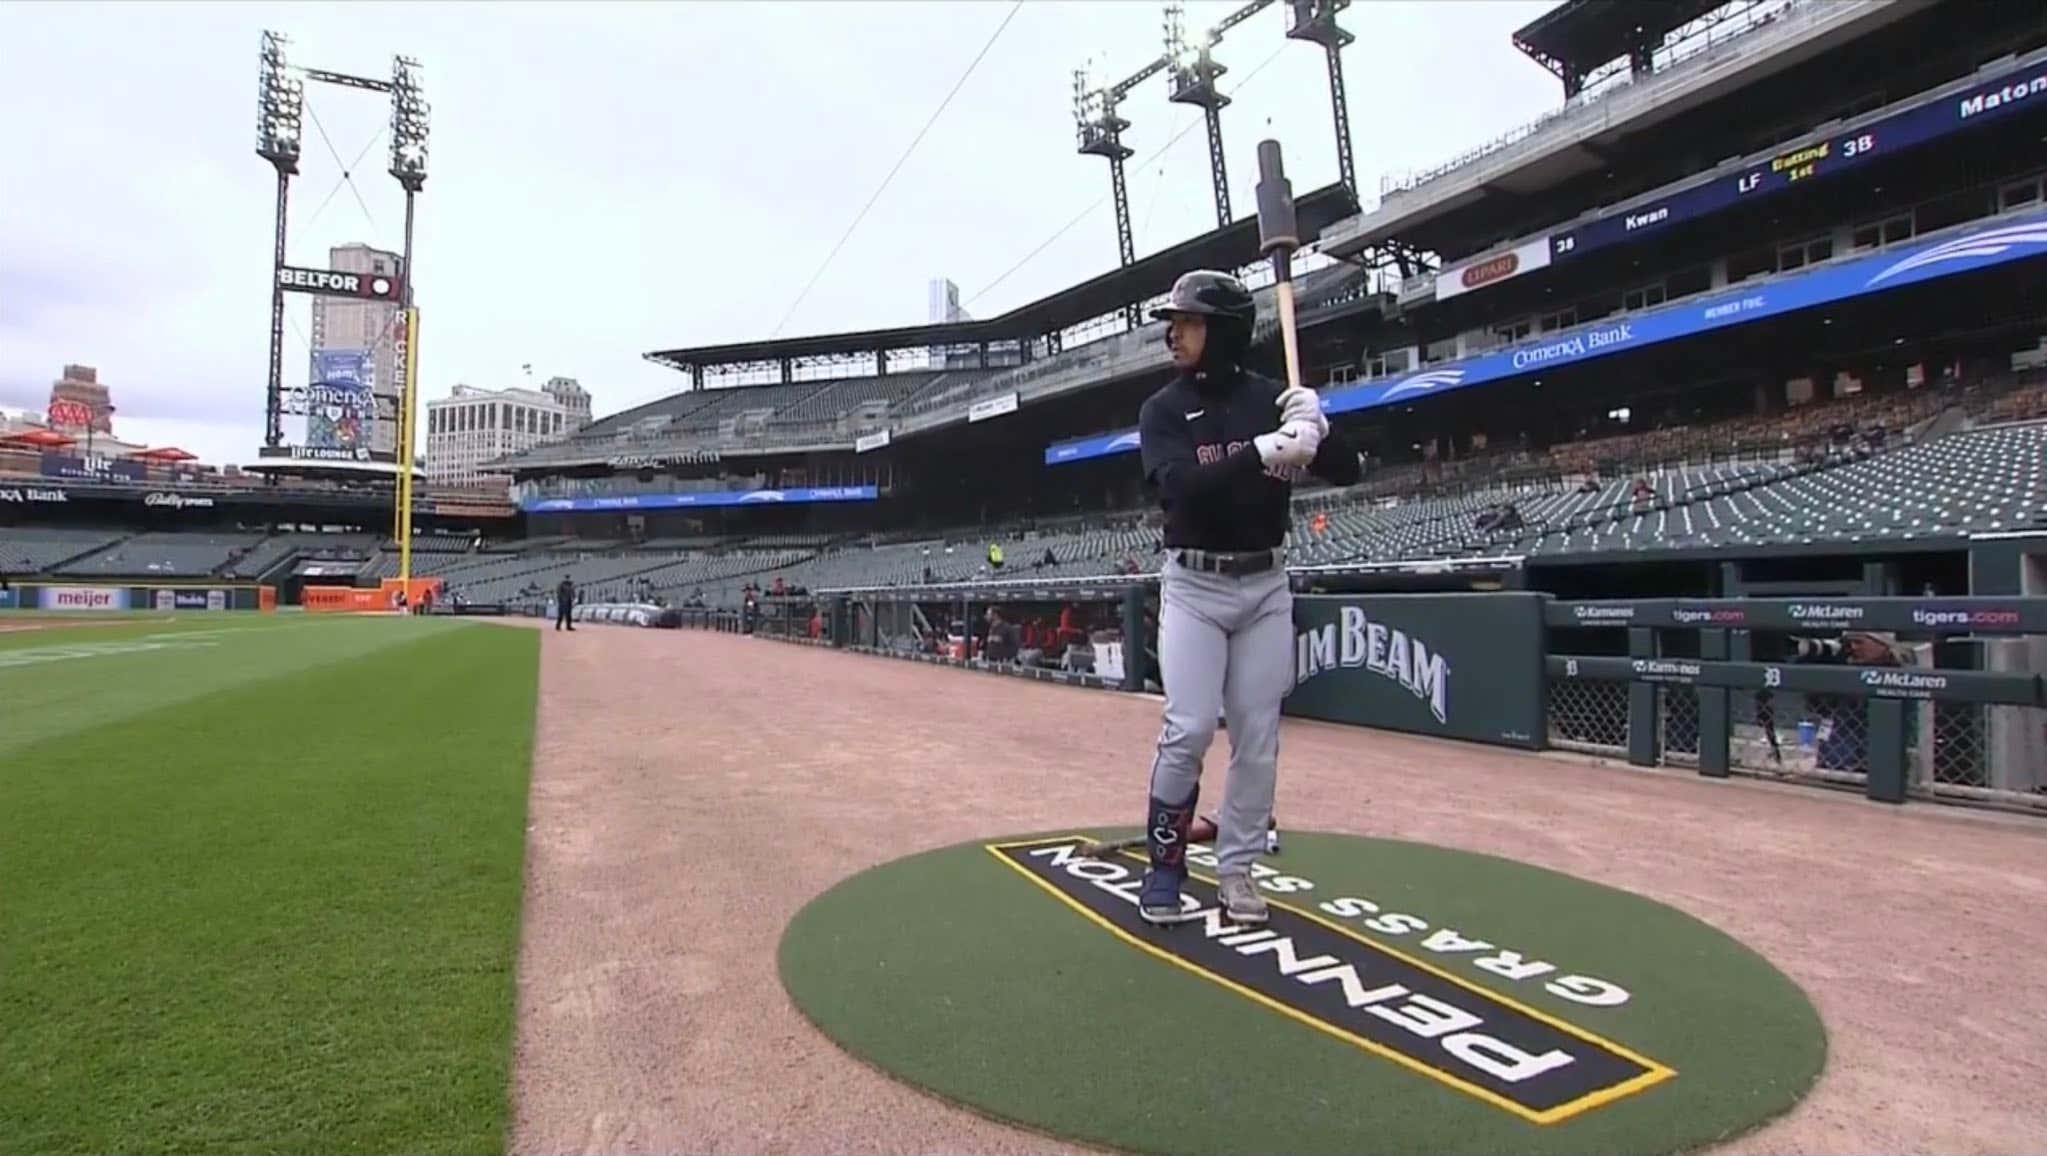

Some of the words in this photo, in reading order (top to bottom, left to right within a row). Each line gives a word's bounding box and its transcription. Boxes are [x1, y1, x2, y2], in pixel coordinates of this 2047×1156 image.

[1843, 134, 1874, 158] 3B
[1738, 172, 1761, 193] LF
[1788, 164, 1815, 182] 1st
[1625, 207, 1669, 231] Kwan
[280, 270, 359, 291] BELFOR
[1588, 325, 1633, 350] Bank
[26, 488, 69, 502] Bank
[57, 588, 111, 608] meijer
[1672, 609, 1745, 623] tigers.com
[1807, 604, 1864, 619] McLaren
[1912, 608, 2019, 626] tigers.com
[1297, 622, 1337, 684] IM
[1340, 606, 1448, 724] BEAM
[1883, 672, 1947, 689] McLaren
[1320, 897, 1631, 1008] GRASS
